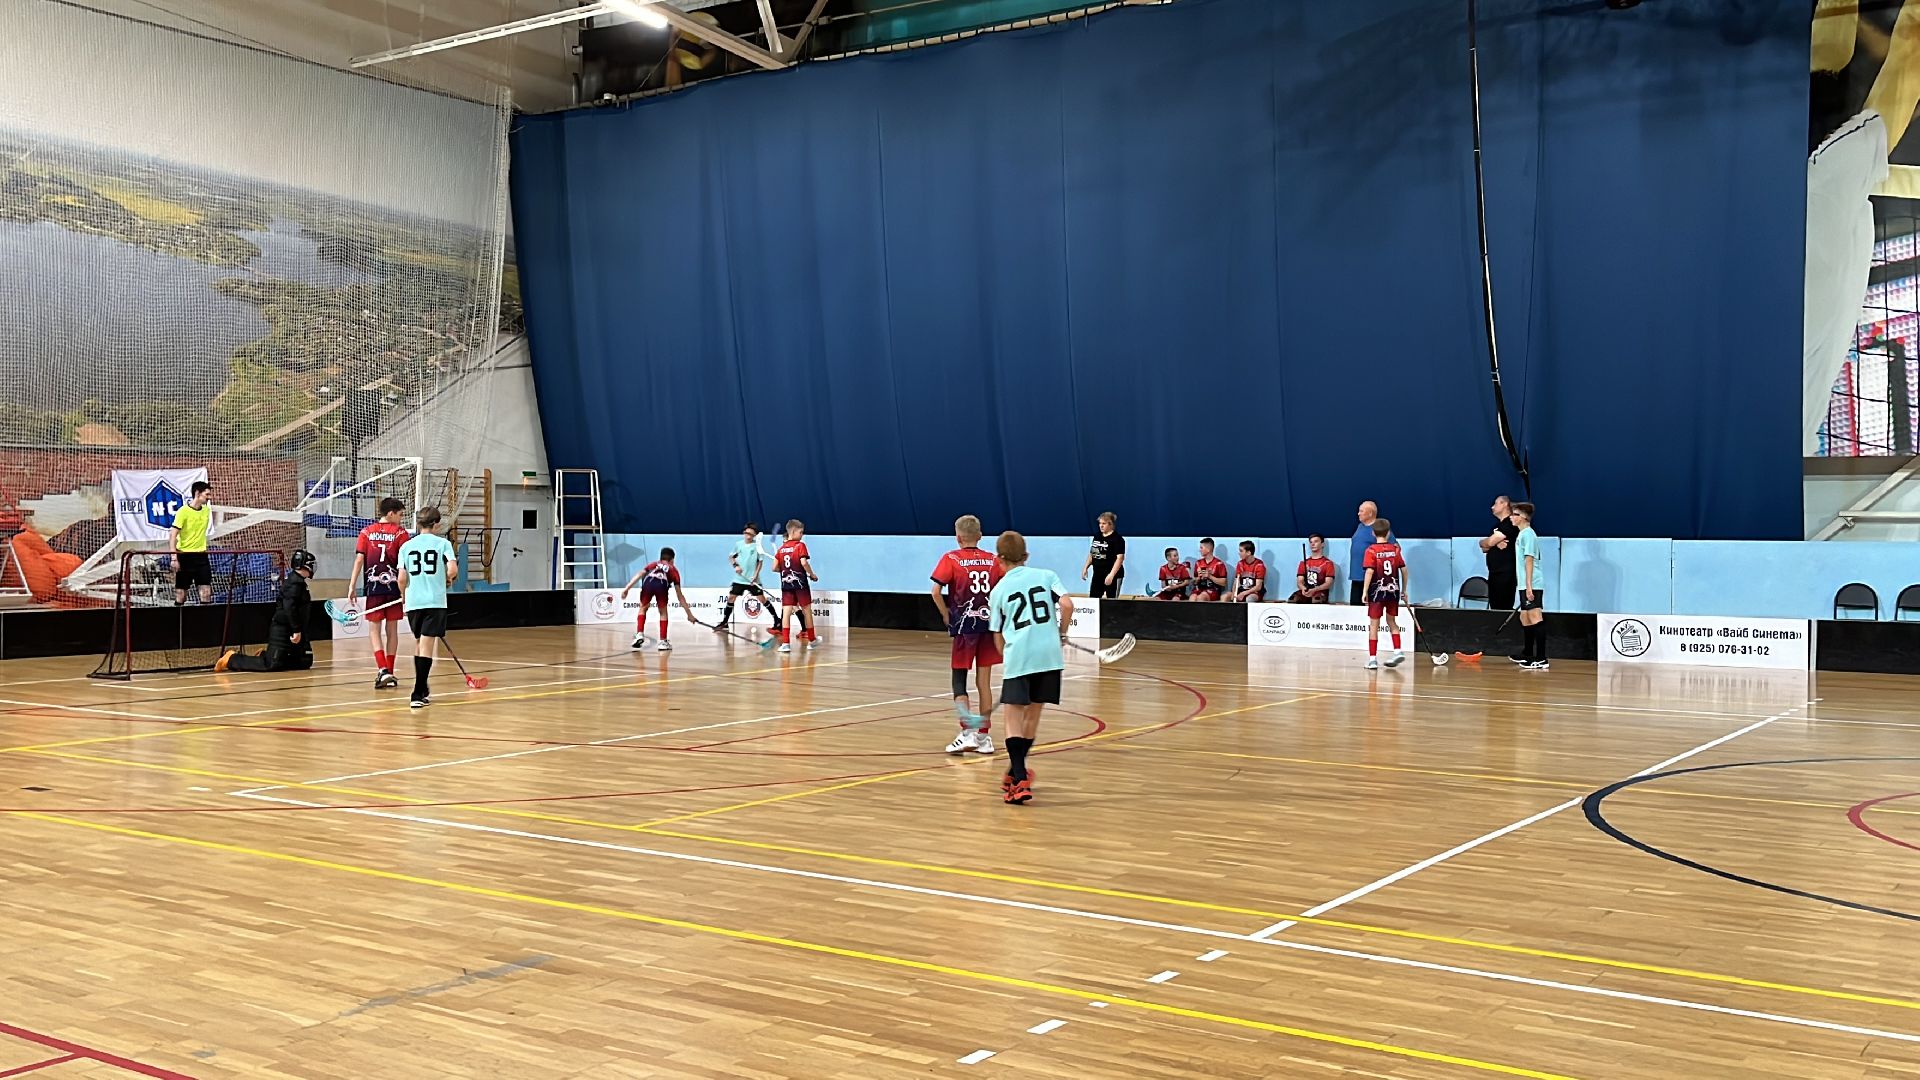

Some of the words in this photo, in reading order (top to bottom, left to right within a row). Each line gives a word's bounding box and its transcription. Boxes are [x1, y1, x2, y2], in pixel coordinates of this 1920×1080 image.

[377, 543, 386, 562] 7
[783, 554, 791, 568] 8
[407, 549, 438, 576] 39
[1383, 559, 1393, 576] 9
[969, 571, 990, 593] 33
[1007, 585, 1051, 631] 26
[1297, 621, 1311, 630] ООО
[1345, 623, 1366, 632] Завод
[1659, 625, 1713, 638] Кинотеатр
[1716, 626, 1749, 638] «Вайб
[1752, 629, 1802, 640] Синема»
[1680, 643, 1687, 652] 8
[1689, 643, 1715, 654] (925)
[1718, 645, 1770, 656] 076-31-02
